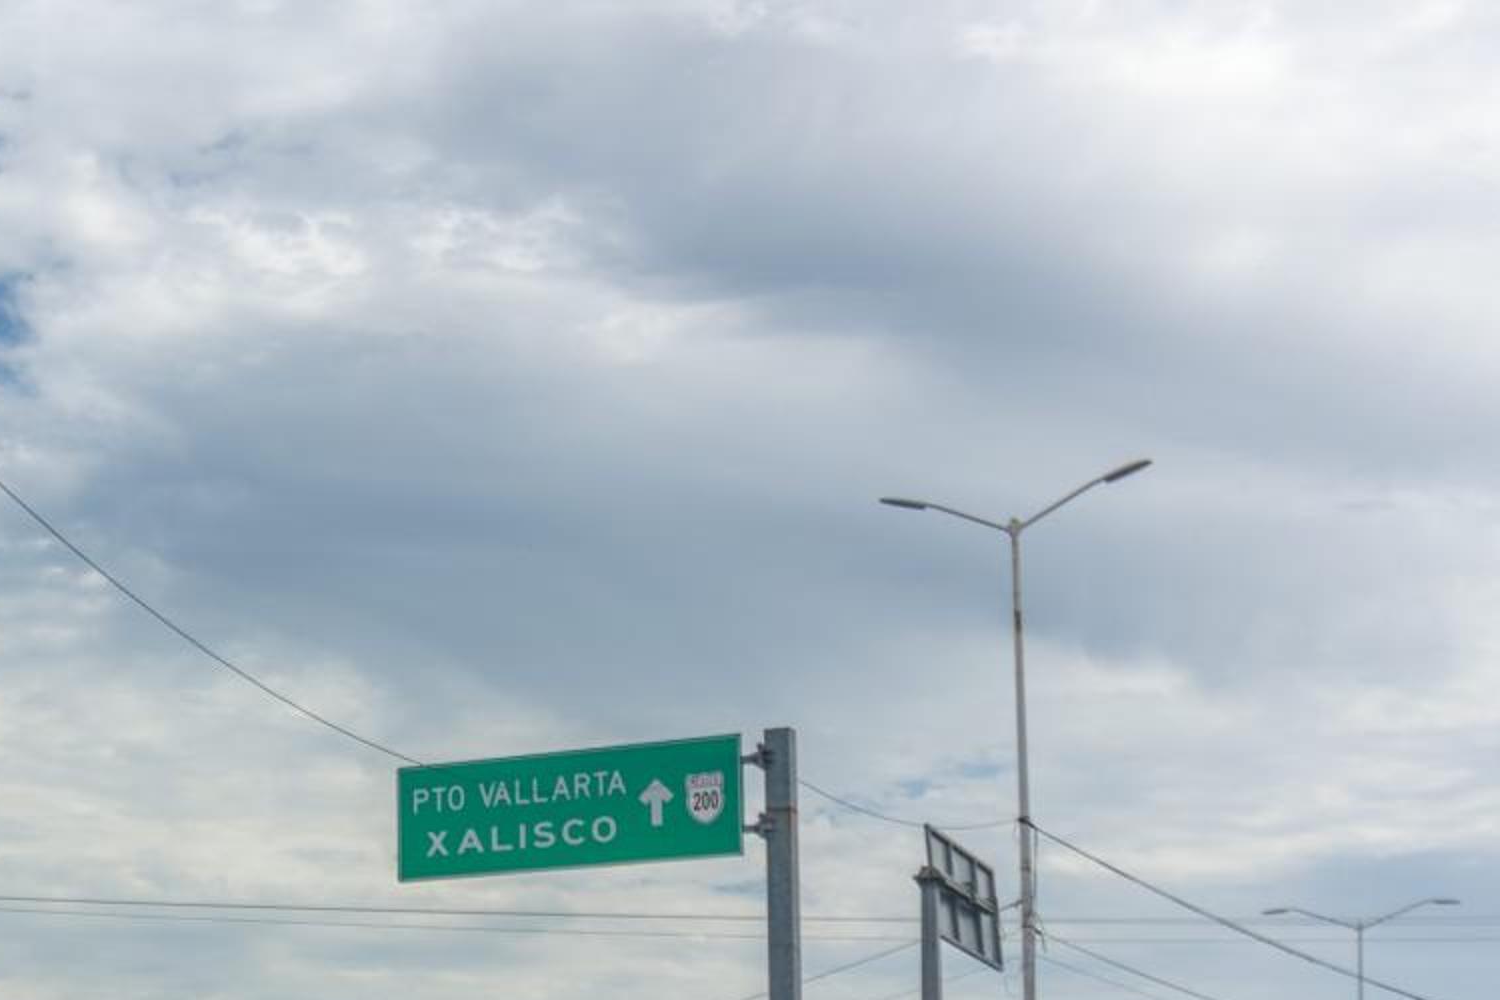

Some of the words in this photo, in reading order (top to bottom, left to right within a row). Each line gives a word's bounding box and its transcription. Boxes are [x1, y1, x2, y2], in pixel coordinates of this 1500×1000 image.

[412, 784, 465, 816] PTO
[479, 770, 628, 809] VALLARTA
[692, 789, 720, 812] 200
[426, 815, 618, 858] XALISCO
